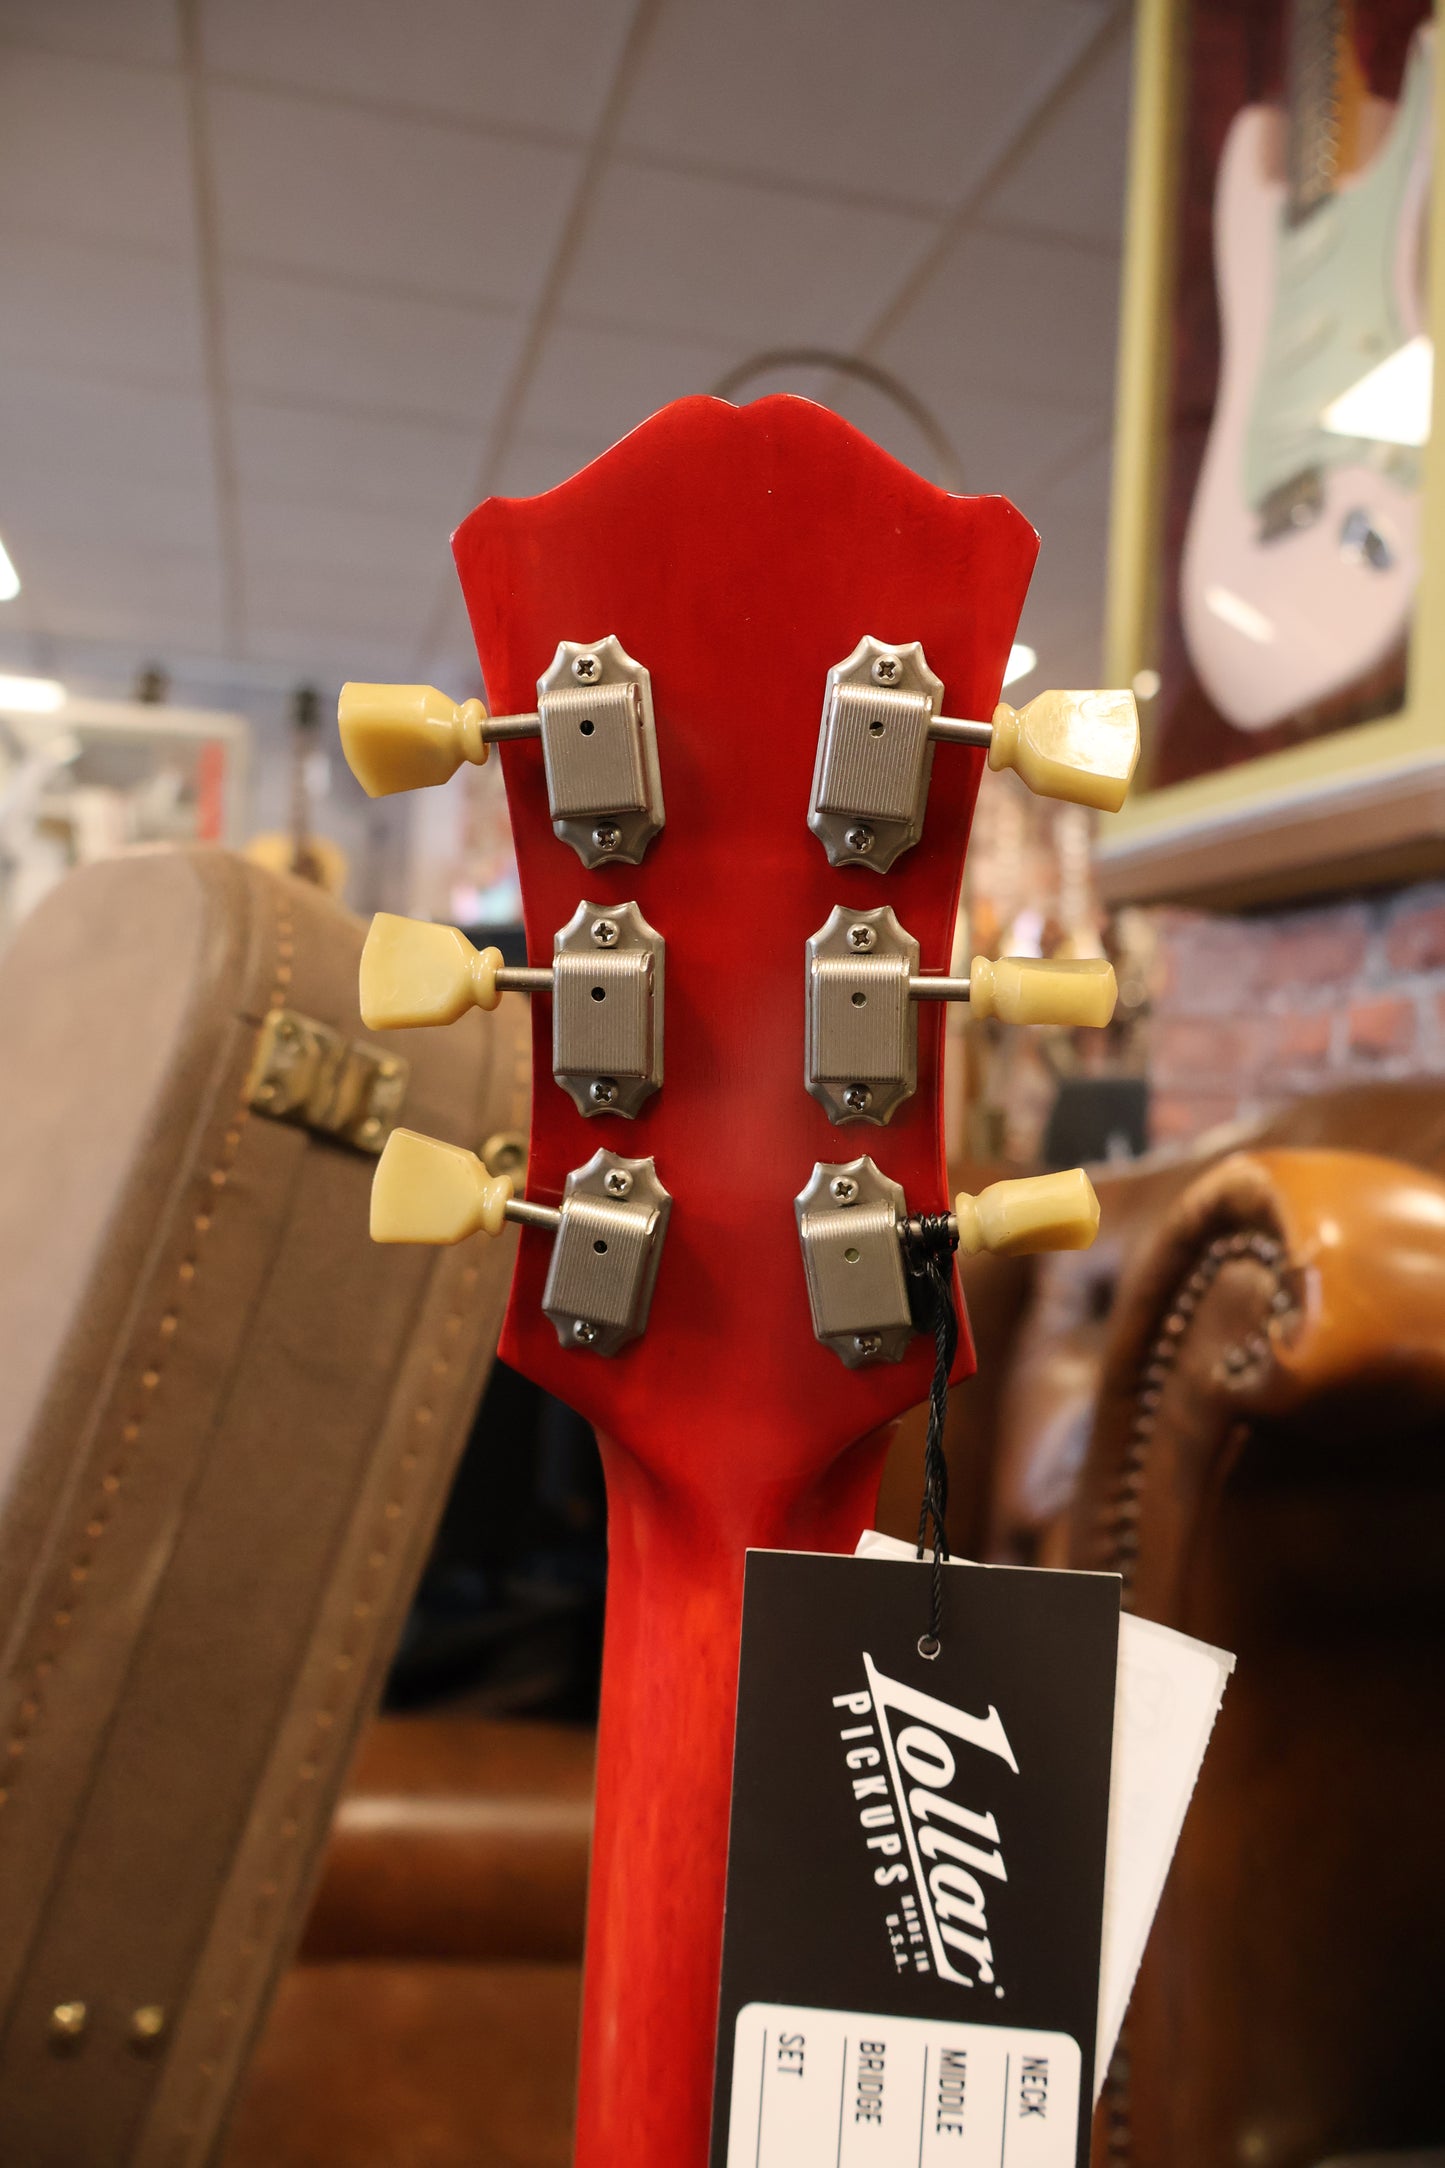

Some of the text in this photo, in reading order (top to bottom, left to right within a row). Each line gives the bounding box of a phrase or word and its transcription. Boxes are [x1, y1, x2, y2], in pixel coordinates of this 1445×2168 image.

[832, 1690, 909, 1886] PICKUPS
[901, 1894, 930, 1973] MADE IN
[777, 2033, 805, 2079] SET
[856, 2040, 885, 2126] BRIDGE
[936, 2048, 967, 2137] MIDDLE
[1019, 2056, 1048, 2119] NECK
